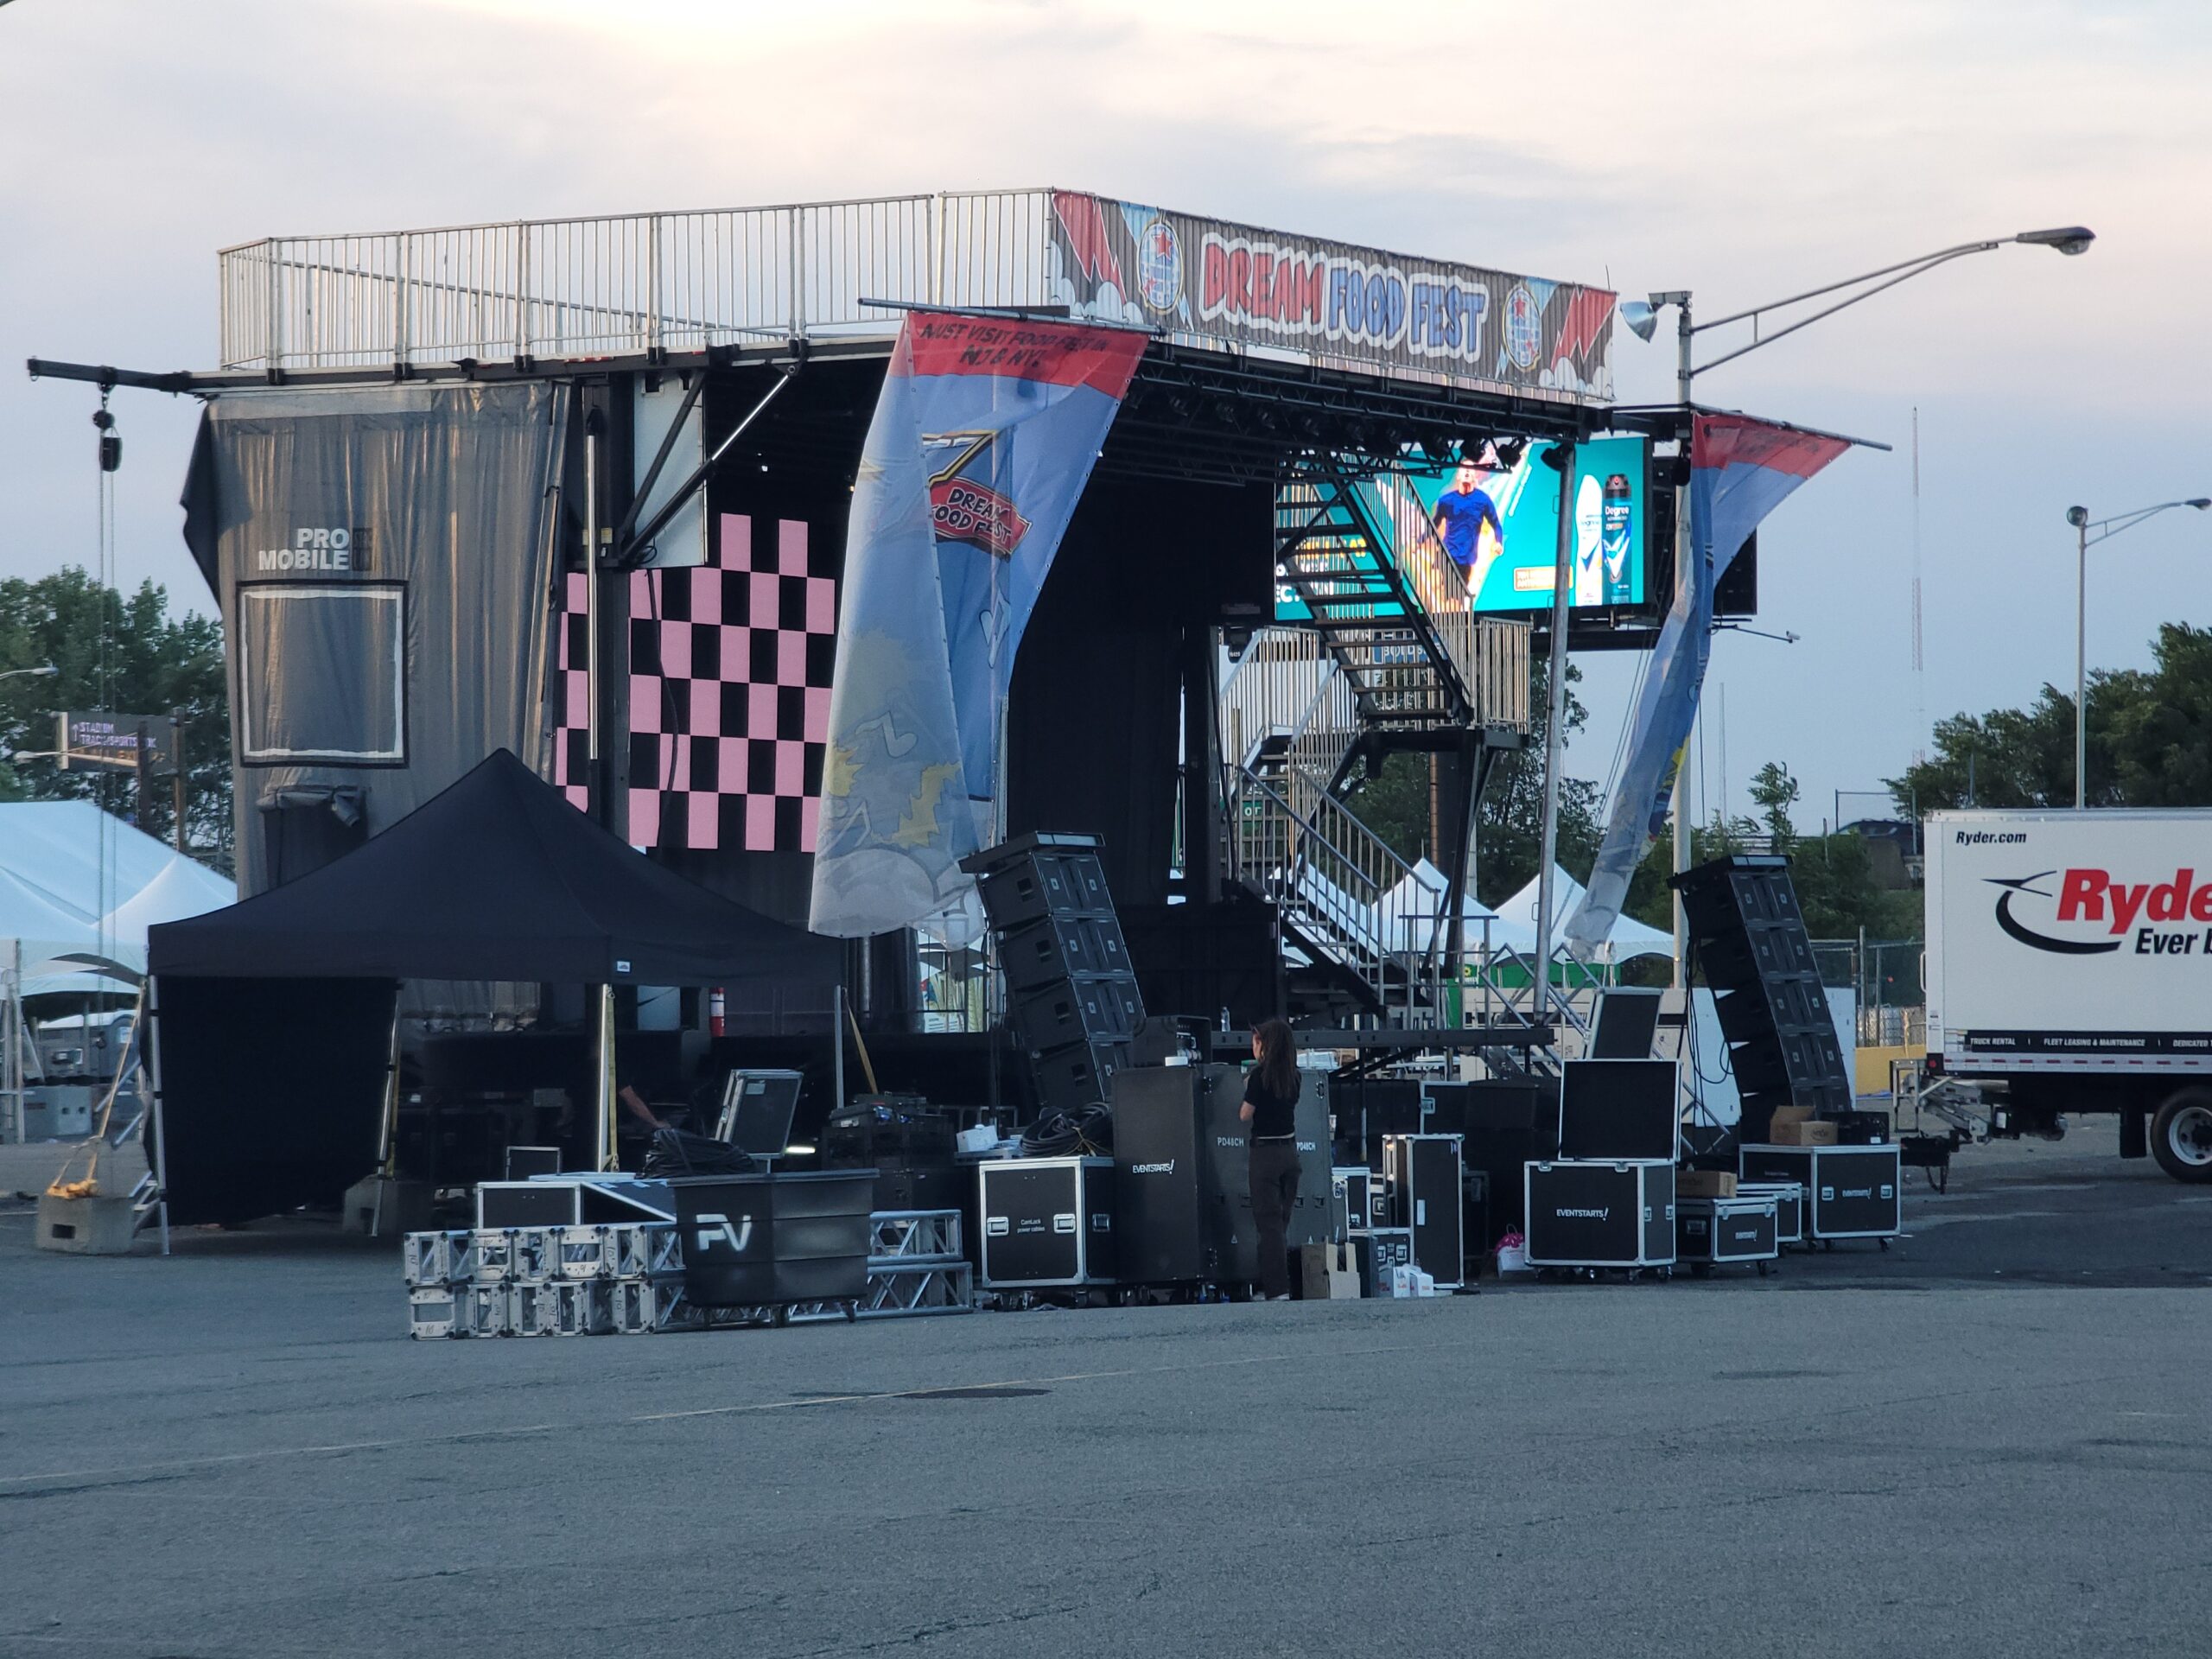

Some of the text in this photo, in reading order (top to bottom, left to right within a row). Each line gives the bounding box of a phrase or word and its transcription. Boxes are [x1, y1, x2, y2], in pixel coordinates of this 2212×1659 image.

[1203, 240, 1486, 354] DREAM FOOD FEST
[967, 325, 1011, 344] VISIT
[1008, 331, 1058, 346] FOOD
[959, 344, 991, 365] NJ
[947, 486, 1011, 522] DREAM
[932, 504, 1012, 543] OOD FEST
[296, 528, 350, 550] PRO
[258, 549, 350, 570] MOBILE
[1955, 831, 2026, 845] Ryder.com
[2135, 928, 2198, 955] Ever
[1132, 1159, 1175, 1175] EVENTSTARTS!
[1556, 1207, 1609, 1222] EVENTSTARTS!
